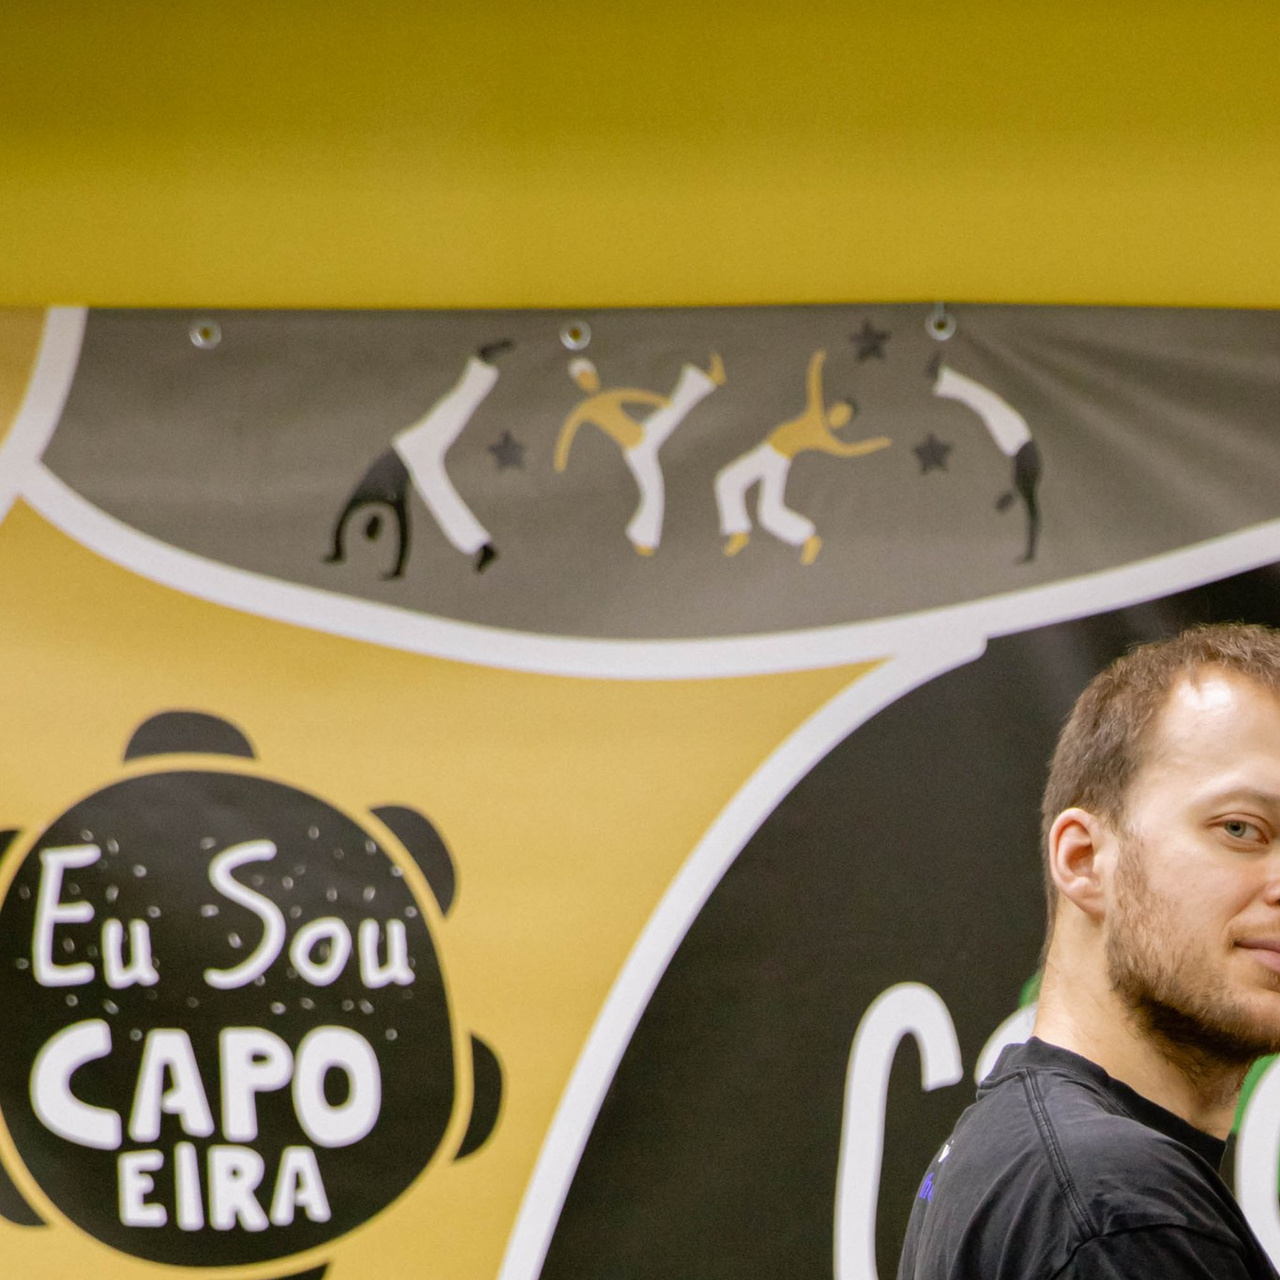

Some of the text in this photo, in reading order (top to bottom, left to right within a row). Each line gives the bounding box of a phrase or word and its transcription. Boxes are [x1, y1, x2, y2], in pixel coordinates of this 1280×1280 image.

[32, 839, 415, 990] Eu Sou
[30, 1018, 382, 1150] CAPO
[118, 1141, 331, 1232] EIRA
